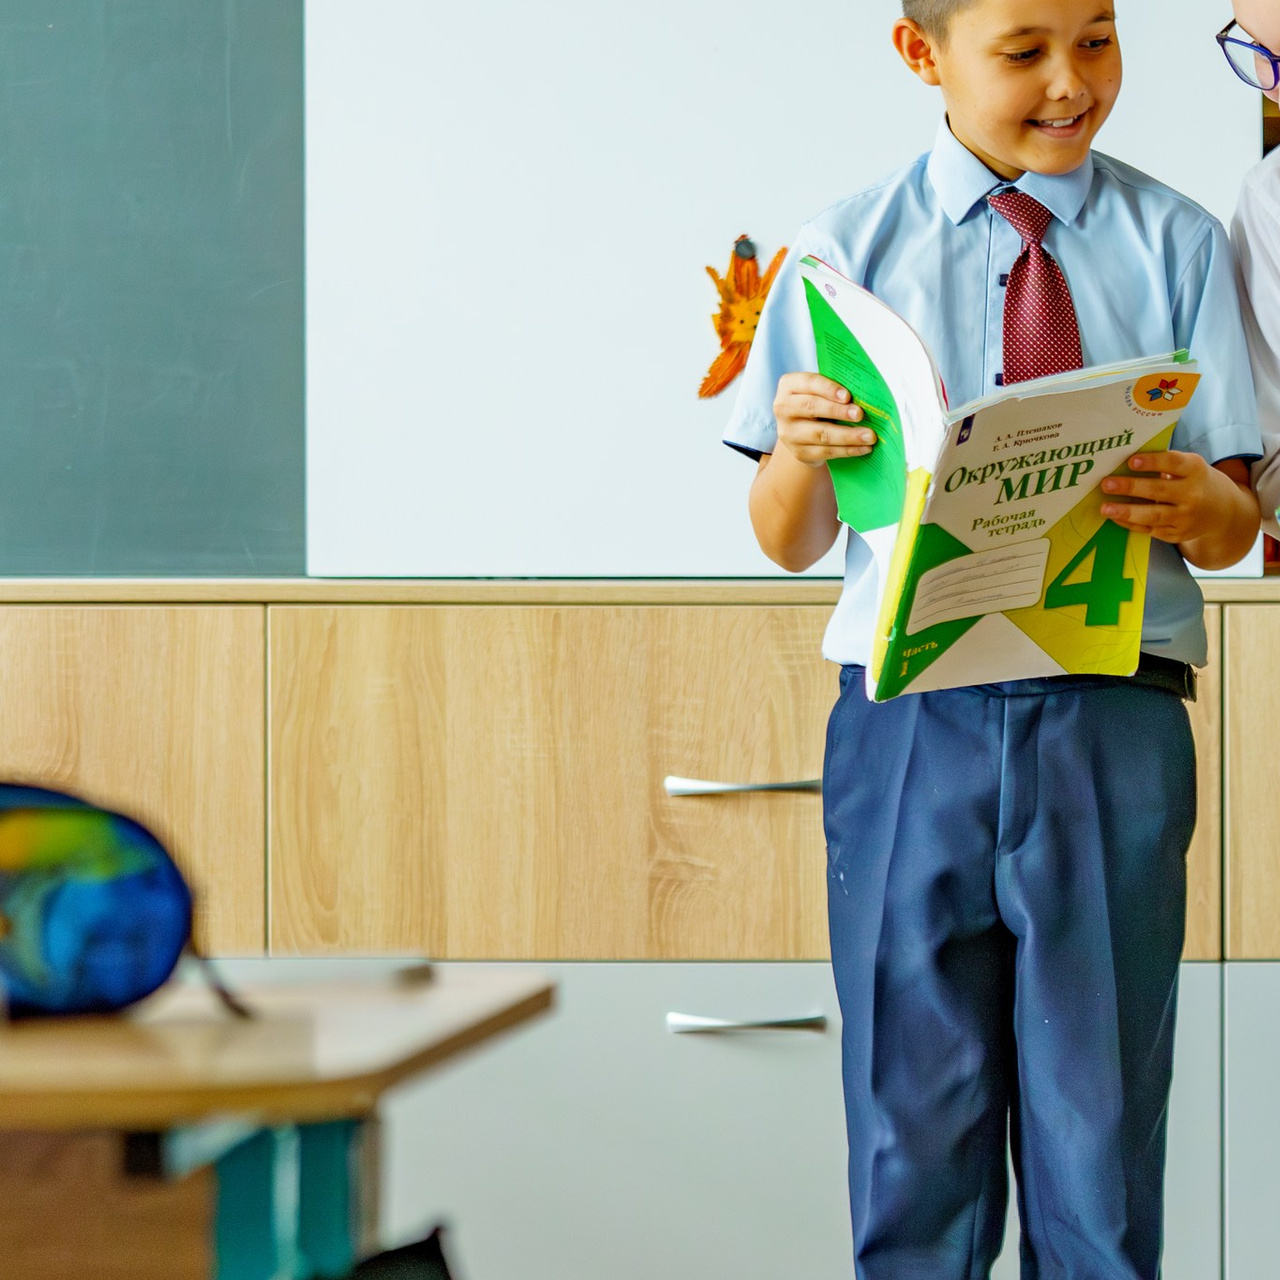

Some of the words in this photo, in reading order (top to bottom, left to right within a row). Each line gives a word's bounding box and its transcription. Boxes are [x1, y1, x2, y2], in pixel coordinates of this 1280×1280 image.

[944, 428, 1135, 494] Окружающий
[993, 458, 1096, 506] МИР
[970, 508, 1036, 533] Рабочая
[987, 518, 1047, 538] тетрадь
[1043, 517, 1135, 627] 4
[902, 641, 939, 659] часть
